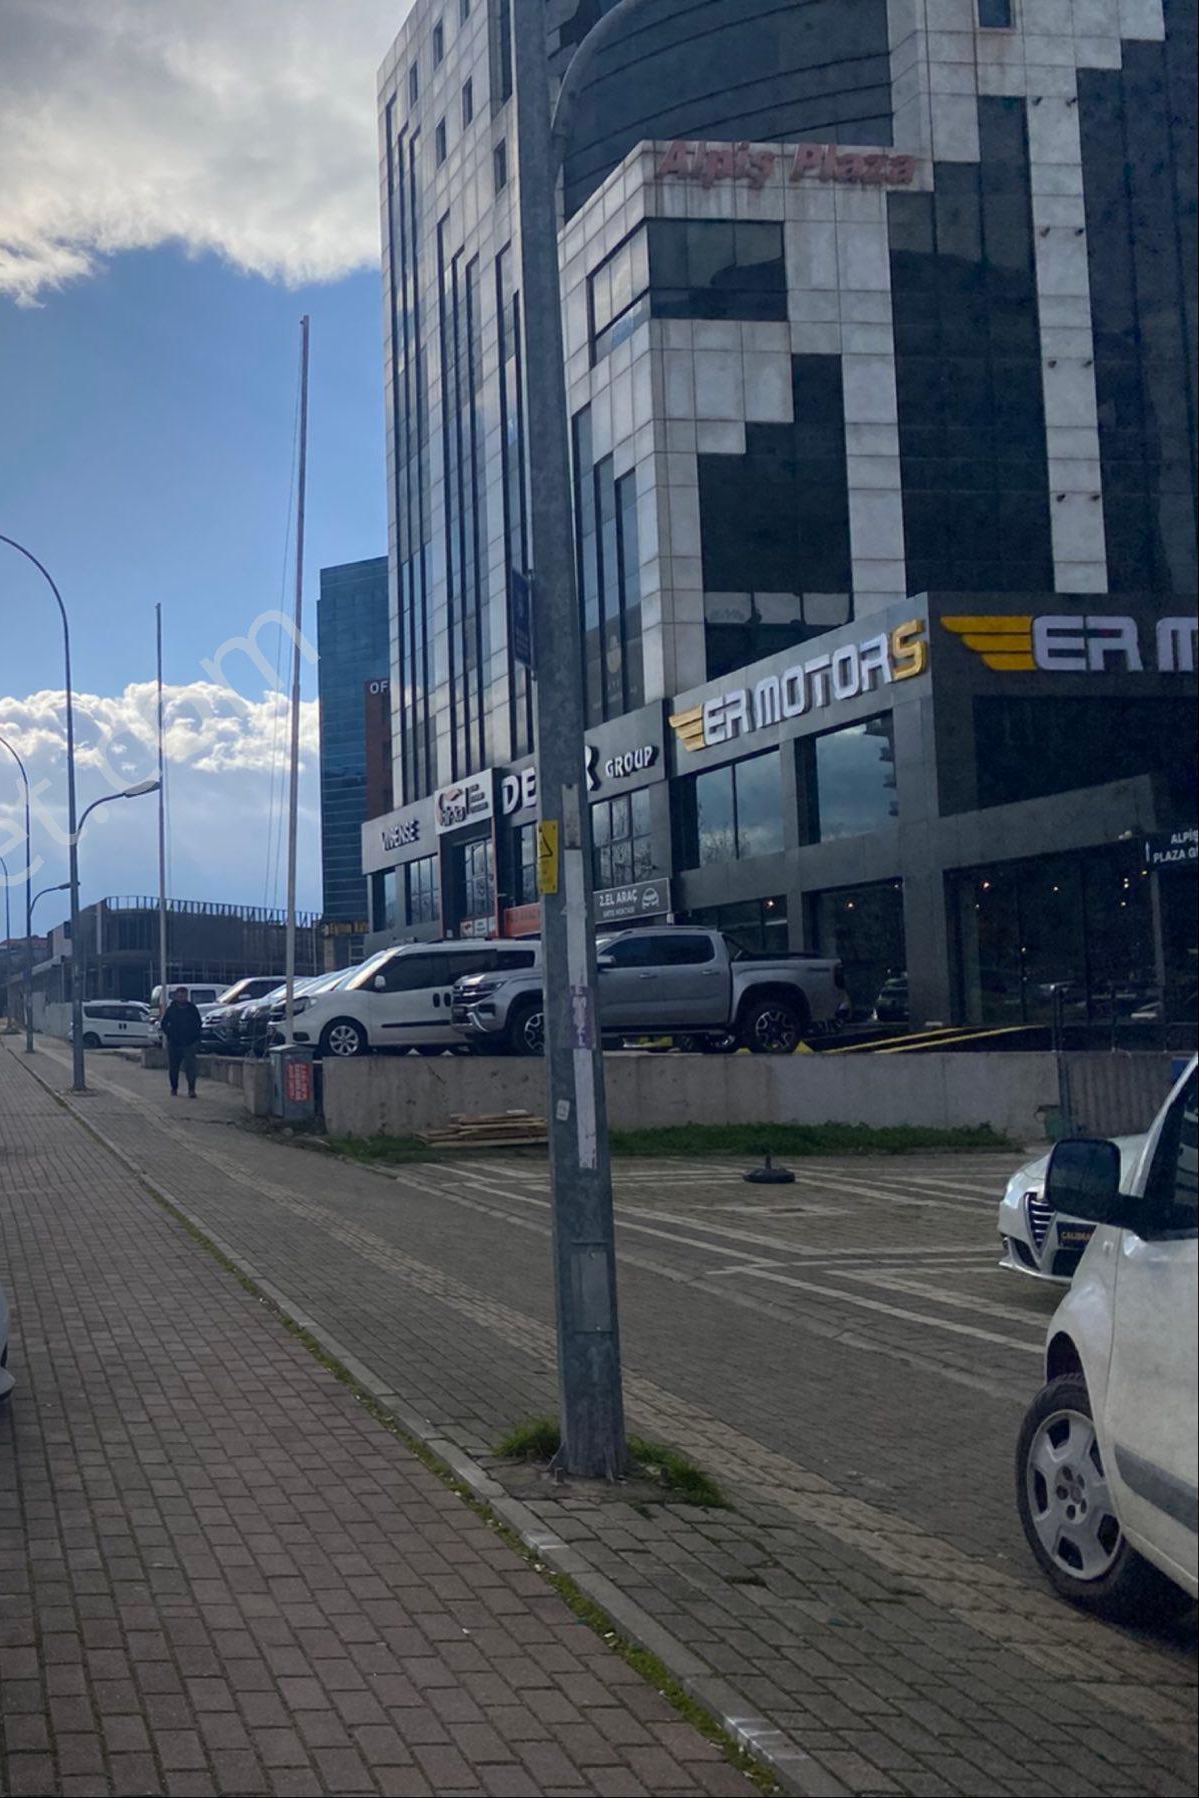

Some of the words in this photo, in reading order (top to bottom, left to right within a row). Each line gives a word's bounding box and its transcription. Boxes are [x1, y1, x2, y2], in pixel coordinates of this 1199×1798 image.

[654, 139, 776, 189] Alpiş
[789, 143, 917, 184] Plaza
[1032, 615, 1144, 671] ER
[703, 688, 749, 746] ER
[754, 618, 929, 729] MOTORS
[605, 745, 654, 778] GROUP
[1153, 849, 1186, 863] PLAZA
